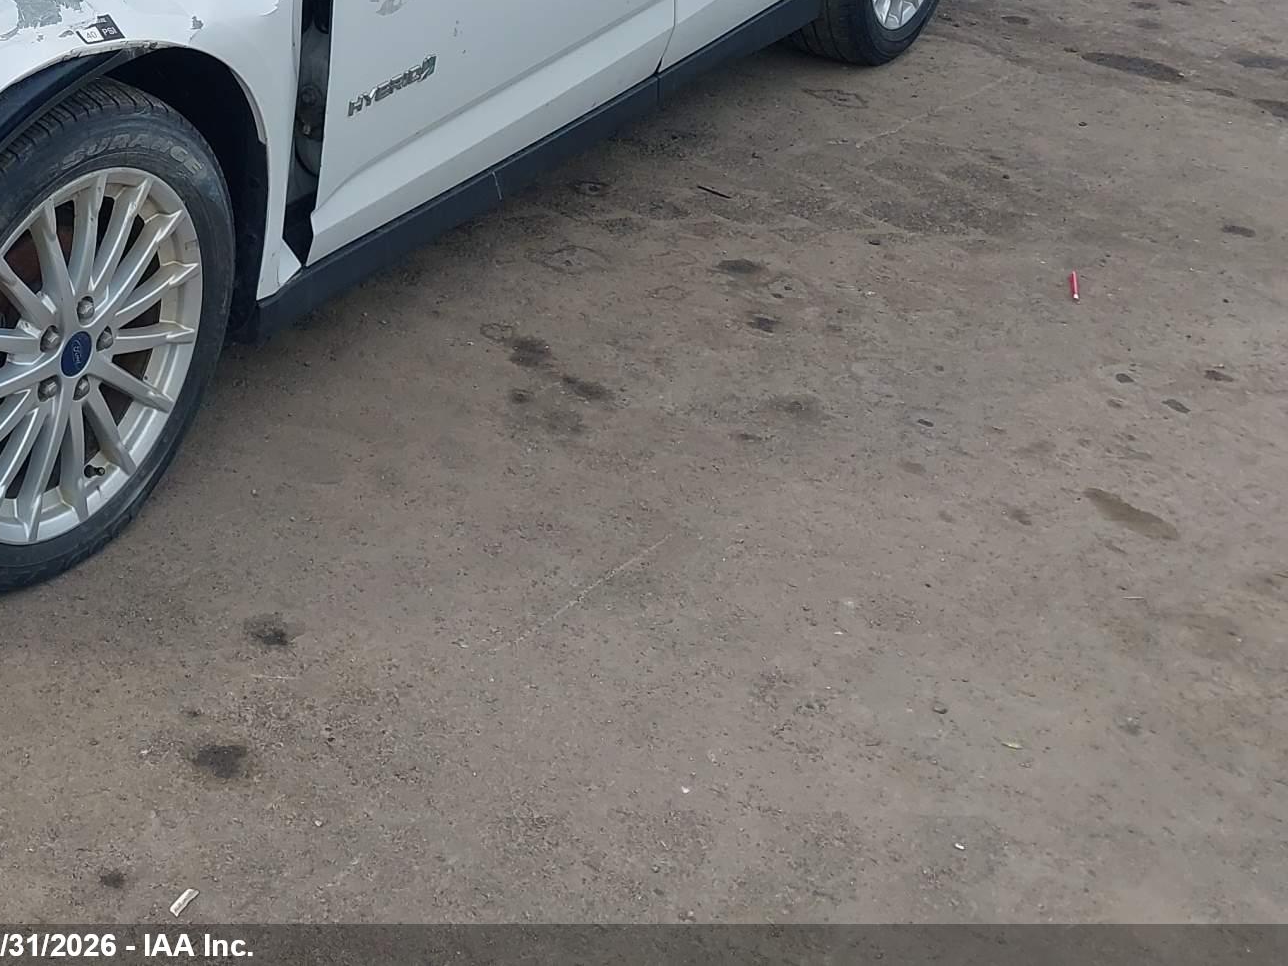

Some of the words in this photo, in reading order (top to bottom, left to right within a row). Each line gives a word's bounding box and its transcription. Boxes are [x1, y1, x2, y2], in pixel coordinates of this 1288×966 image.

[101, 26, 118, 36] PSI
[347, 64, 423, 117] HYBRID
[49, 133, 205, 176] SURANCE
